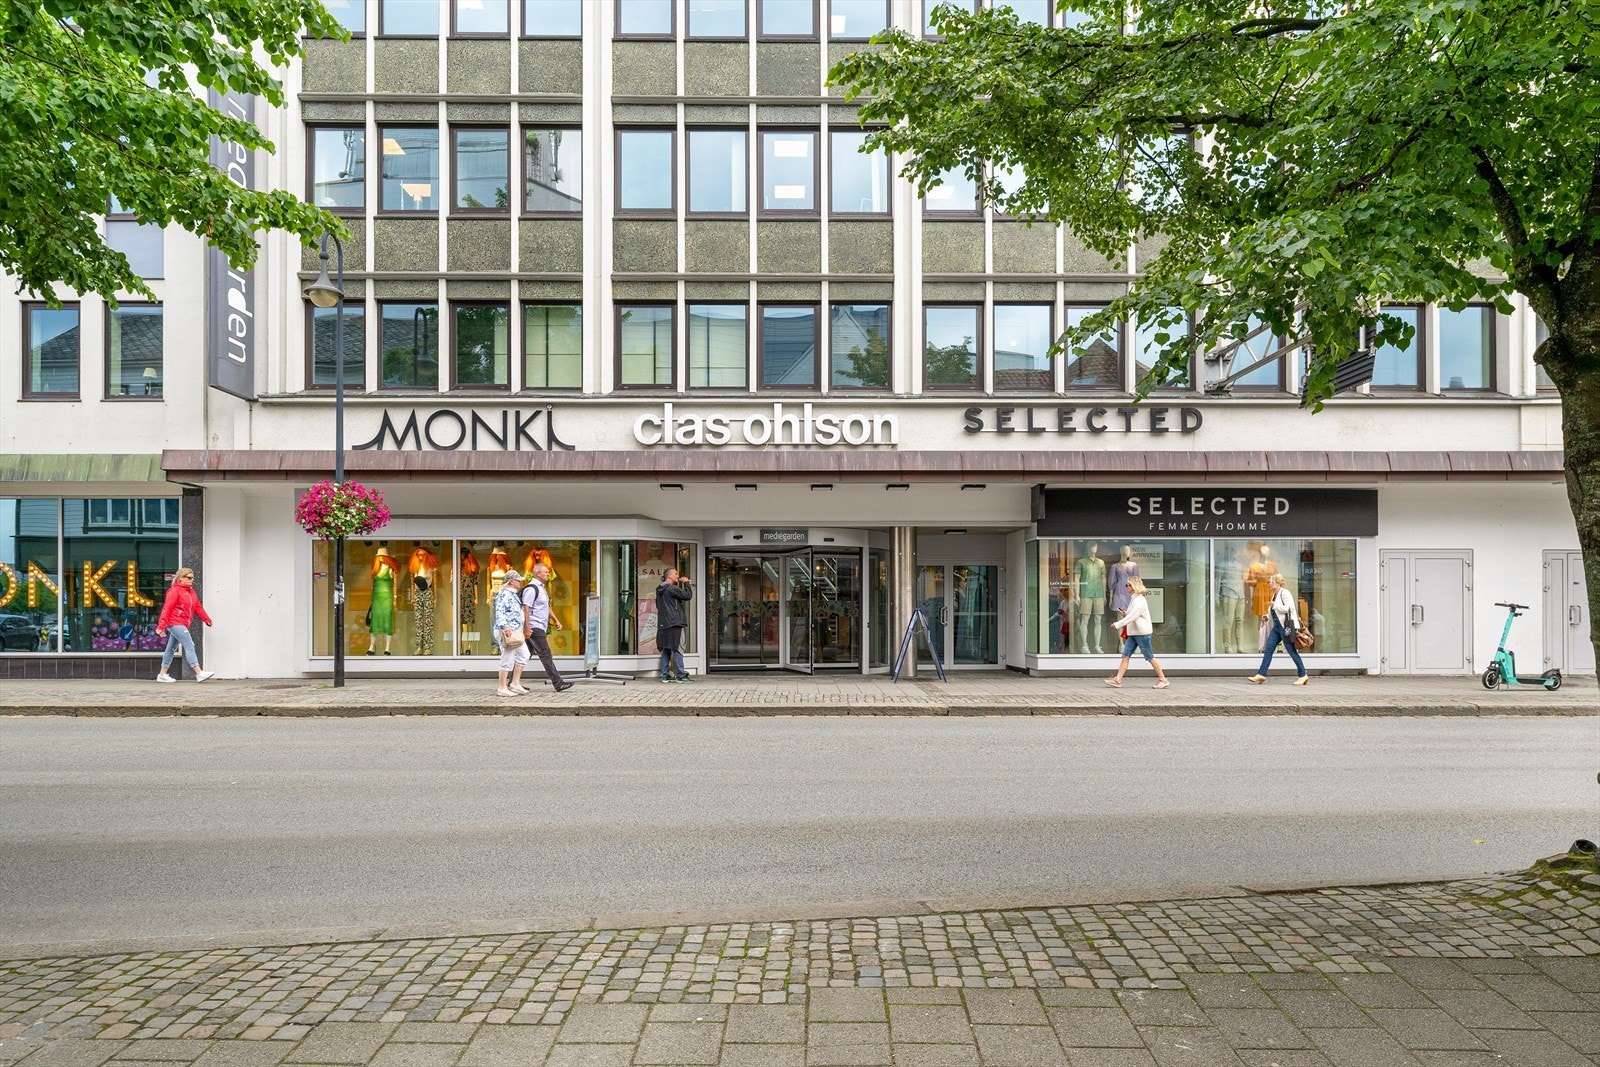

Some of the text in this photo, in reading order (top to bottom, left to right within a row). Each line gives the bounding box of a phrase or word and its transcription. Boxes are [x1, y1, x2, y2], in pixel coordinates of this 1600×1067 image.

[352, 404, 576, 451] MONKI
[633, 403, 898, 445] clas ohlson
[964, 407, 1203, 433] SELECTED
[1128, 497, 1290, 515] SELECTED
[1149, 522, 1198, 531] FEMME
[1216, 522, 1267, 531] HOMME
[763, 531, 805, 542] mediegarden
[642, 568, 664, 576] SAL
